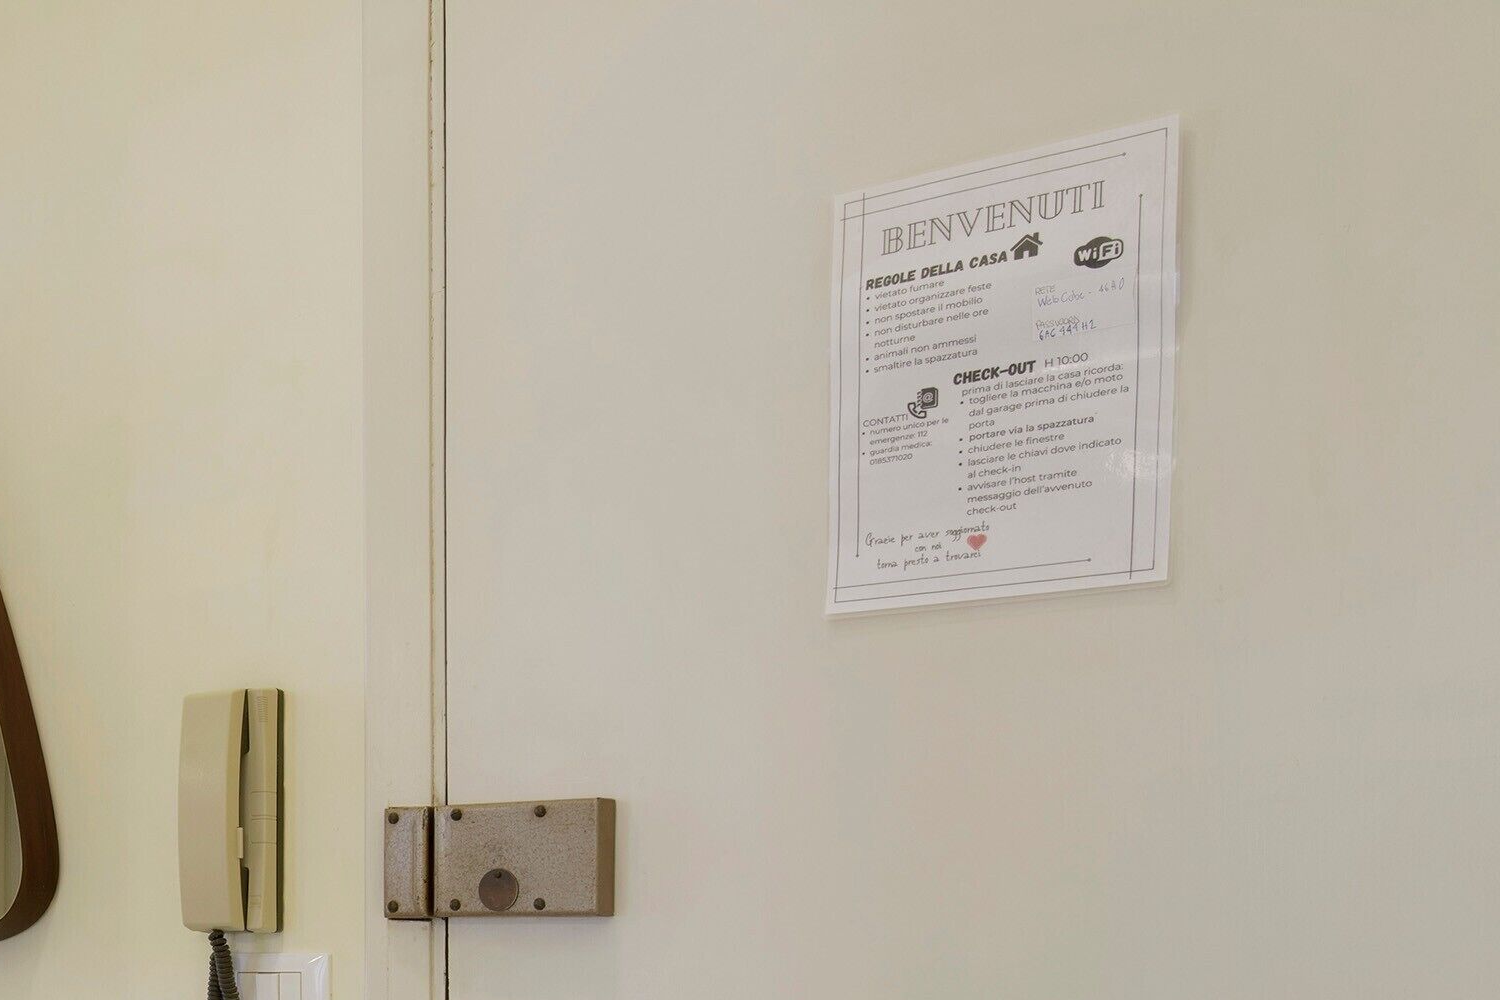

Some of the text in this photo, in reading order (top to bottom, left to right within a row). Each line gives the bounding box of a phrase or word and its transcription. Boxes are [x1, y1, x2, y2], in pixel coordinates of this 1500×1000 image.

[881, 180, 1105, 256] BENVENUTI
[1076, 240, 1122, 263] WiFi
[866, 251, 1008, 290] REGOLE DELLA CASA
[875, 280, 945, 300] vietato fumare
[875, 282, 992, 312] vietato organizzare feste
[874, 296, 983, 324] non spostare il mobilio
[874, 308, 989, 337] non disturbare nelle ore
[874, 335, 916, 349] notturne
[874, 334, 977, 361] animali non ammessi
[873, 348, 978, 374] smaltire la spazzatura
[953, 352, 1089, 385] CHECK-OUT H 10:00
[961, 363, 1124, 397] prima di lasciare la casa ricorda:
[969, 374, 1124, 405] togliere la macchina e/o moto
[968, 385, 1129, 417] dal garage prima di chiudere la
[862, 413, 909, 428] CONTATTI
[869, 425, 901, 435] numero
[902, 421, 925, 431] unico
[926, 419, 940, 428] per
[968, 419, 996, 431] porta
[969, 416, 1095, 442] portare via la spazzatura
[917, 430, 928, 438] 112
[967, 433, 1065, 454] chiudere le finestre
[869, 445, 900, 457] guardia
[968, 437, 1122, 467] lasciare le chiavi dove indicato
[967, 464, 1021, 479] al check-in
[967, 479, 1007, 491] avvisare
[1039, 469, 1077, 481] tramite
[967, 489, 1022, 503] messaggio
[966, 503, 1017, 516] check-out
[901, 534, 914, 547] per
[917, 531, 940, 539] aver
[945, 520, 990, 542] soggiornato
[914, 541, 942, 553] con noi
[877, 559, 899, 570] torna
[903, 553, 929, 571] presto
